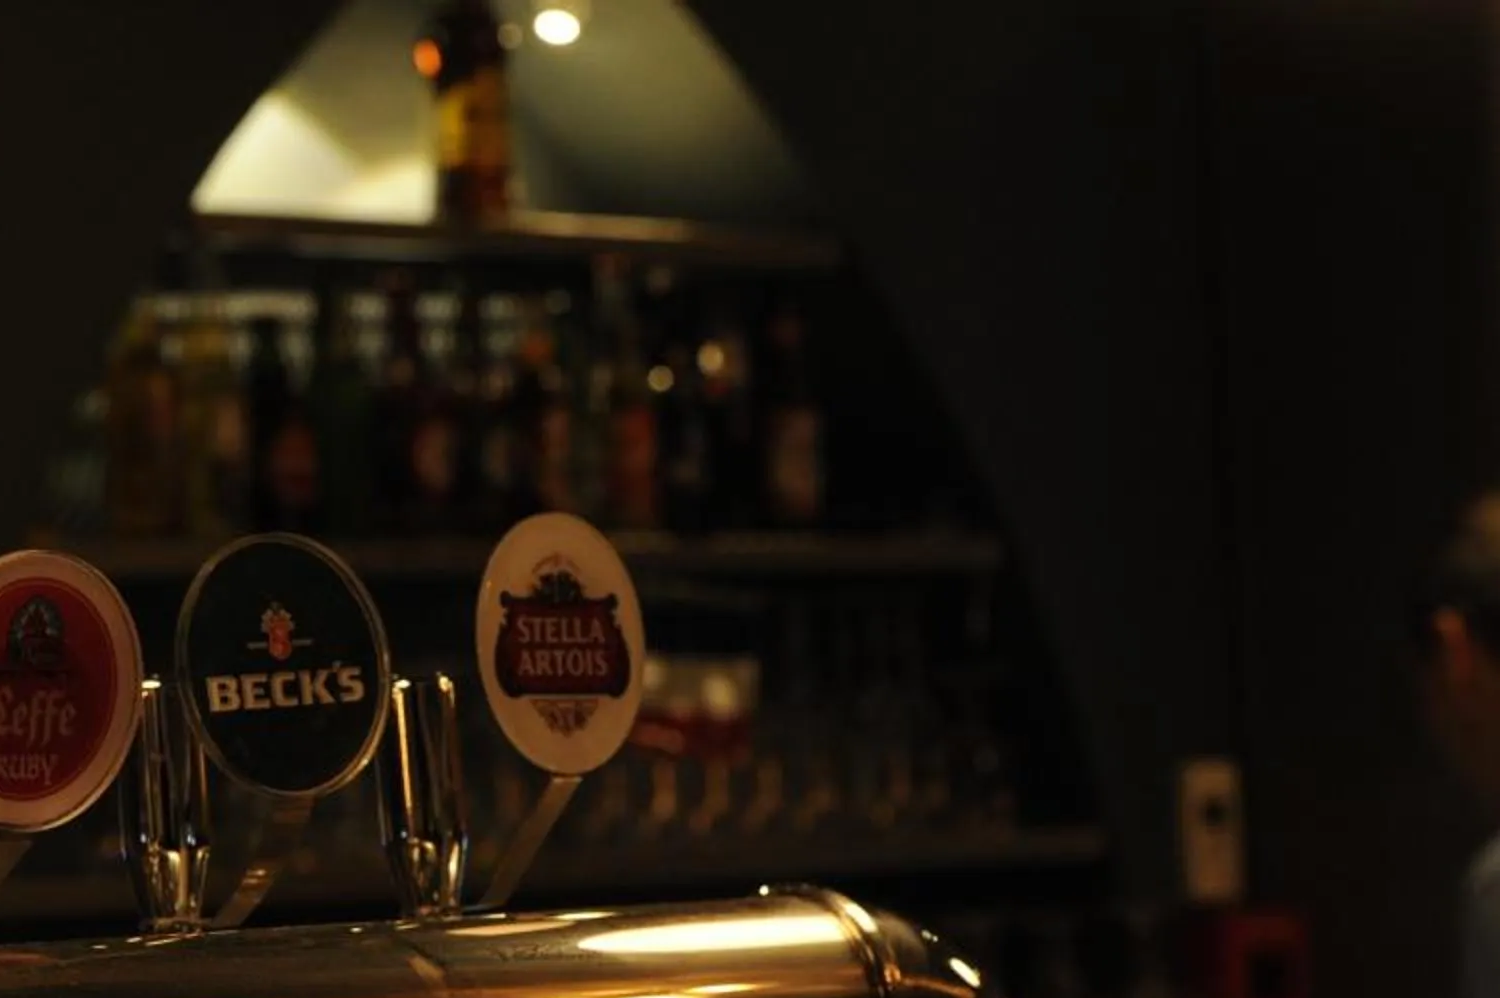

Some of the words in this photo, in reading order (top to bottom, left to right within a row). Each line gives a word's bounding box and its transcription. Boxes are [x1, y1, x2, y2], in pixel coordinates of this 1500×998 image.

[516, 614, 606, 644] STELLA
[517, 646, 610, 678] ARTOIS
[204, 660, 366, 714] BECK'S
